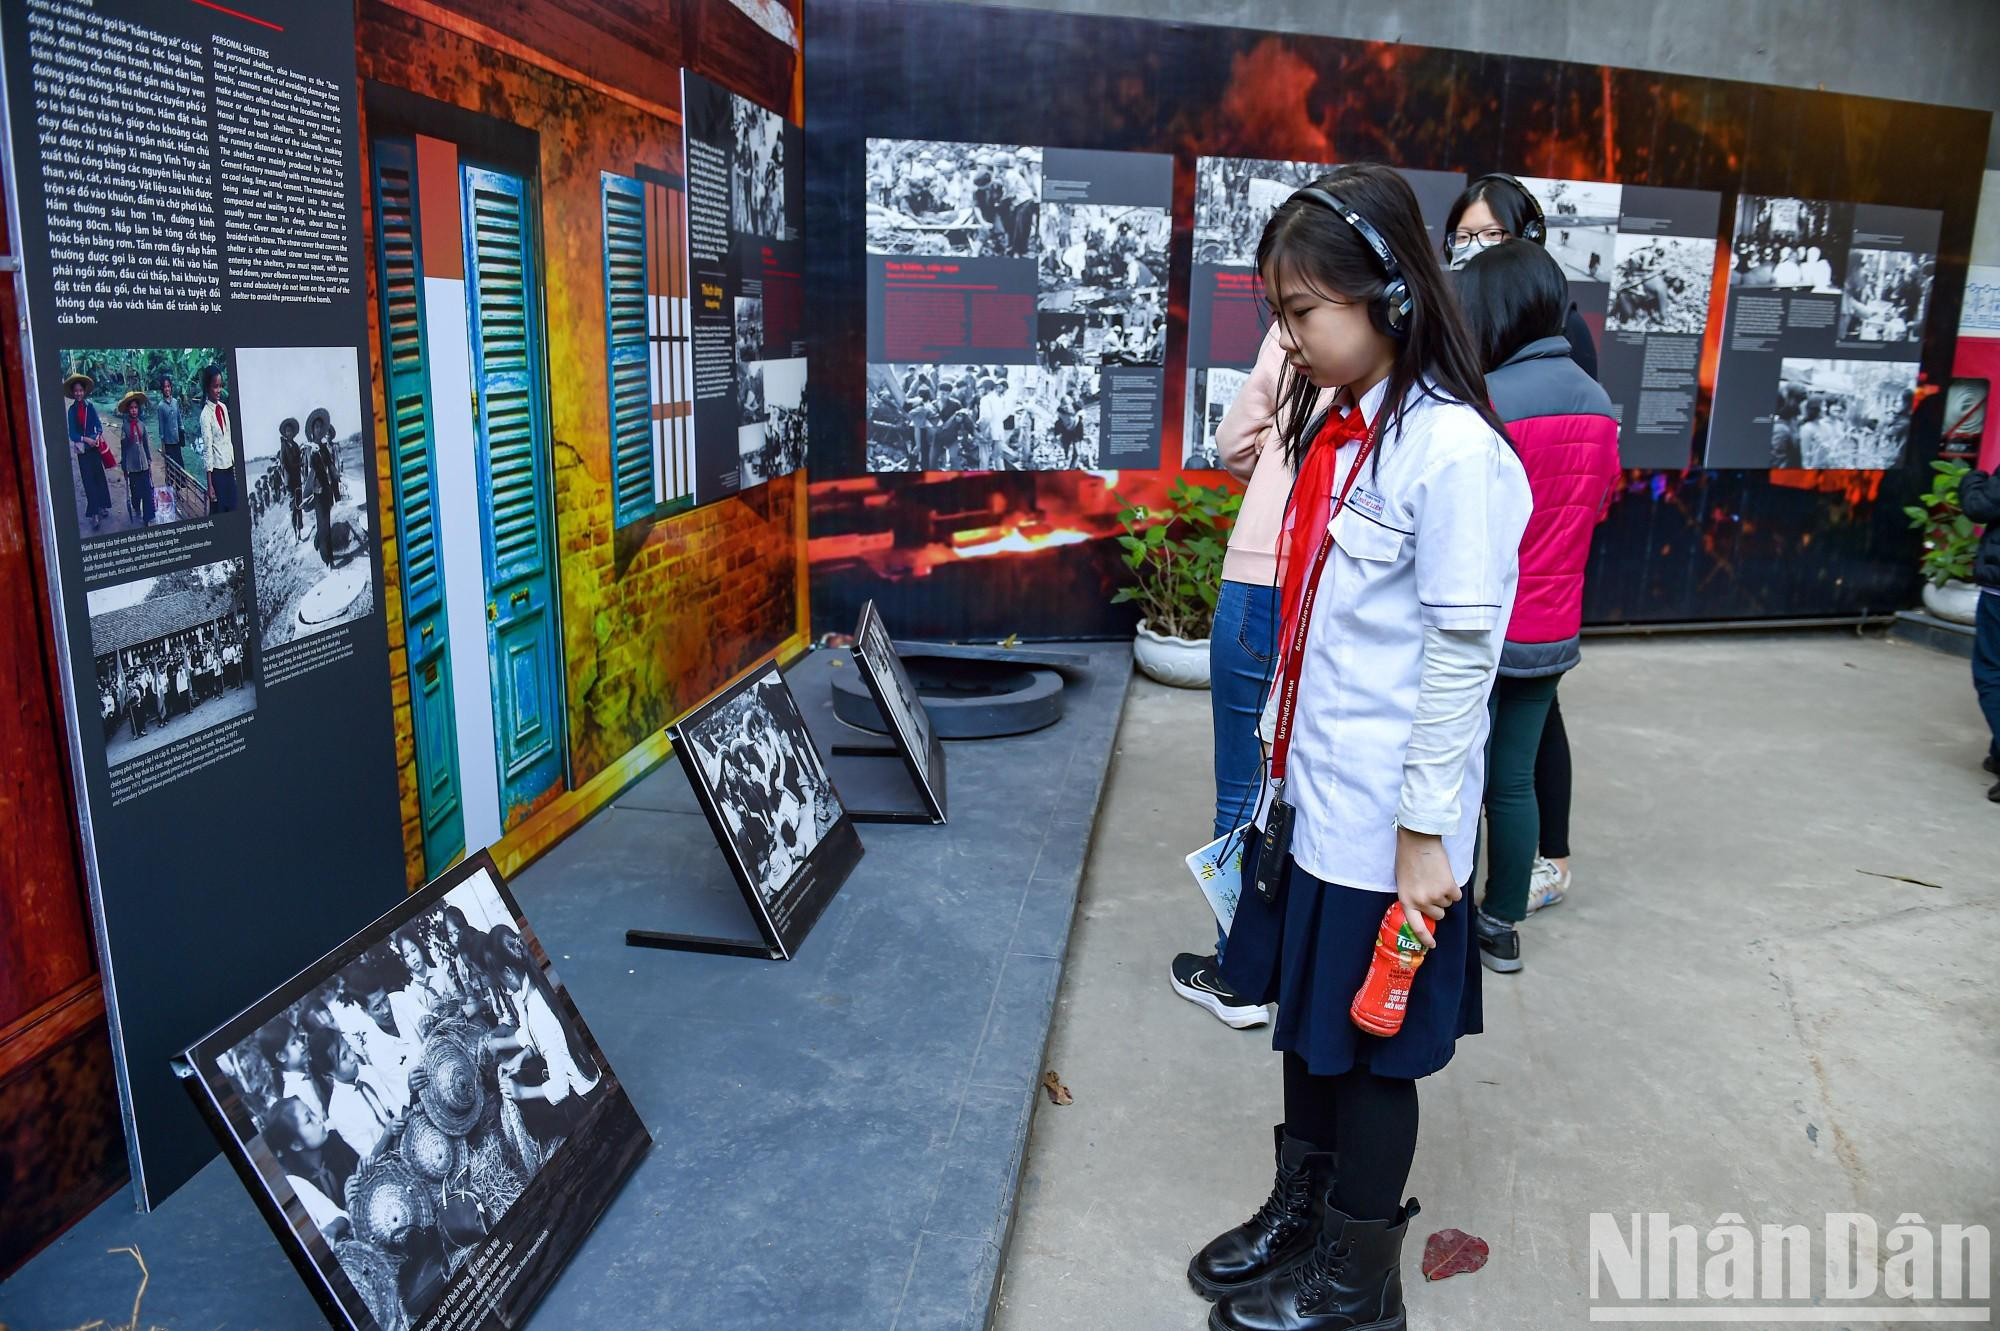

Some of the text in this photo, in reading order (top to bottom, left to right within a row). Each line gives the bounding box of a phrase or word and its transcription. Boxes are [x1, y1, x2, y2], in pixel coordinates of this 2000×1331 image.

[212, 34, 269, 59] PERSONAL SHELTERS
[43, 182, 64, 196] trộn
[65, 184, 76, 196] sẽ
[77, 185, 89, 197] đổ
[90, 188, 106, 199] vào
[107, 189, 136, 205] khuôn,
[155, 197, 165, 207] và
[180, 200, 197, 212] phơi
[198, 202, 214, 213] khô.
[45, 197, 215, 227] Hầm thường sâu hơn 1m, đường kính
[47, 214, 82, 231] khoảng
[85, 219, 112, 231] 80cm.
[134, 223, 150, 235] làm
[152, 225, 162, 236] bê
[165, 227, 183, 241] tông
[185, 228, 197, 240] cốt
[199, 231, 216, 244] thép
[48, 230, 71, 246] hoặc
[92, 234, 114, 250] bằng
[116, 239, 135, 248] rơm.
[135, 238, 153, 250] Tấm
[154, 243, 170, 251] rơm
[201, 244, 217, 255] hầm
[50, 247, 85, 263] thường
[87, 250, 109, 264] được
[111, 253, 125, 266] gọi
[127, 253, 136, 264] là
[138, 256, 153, 265] con
[172, 257, 185, 267] Khi
[187, 258, 201, 268] vào
[202, 259, 218, 270] hầm
[52, 264, 73, 277] phải
[75, 265, 95, 279] ngồi
[119, 267, 135, 279] đầu
[136, 269, 148, 280] cúi
[149, 270, 170, 283] thấp,
[170, 271, 183, 282] hai
[208, 275, 219, 286] tay
[54, 280, 220, 299] đặt trên đầu gối, che hai tai và tuyệt đối
[55, 296, 222, 314] không dựa vào vách hầm để tránh áp lực
[57, 312, 98, 324] của bom.
[1295, 589, 1313, 652] www.orpheo.org
[1278, 680, 1294, 740] www.orpheo.org
